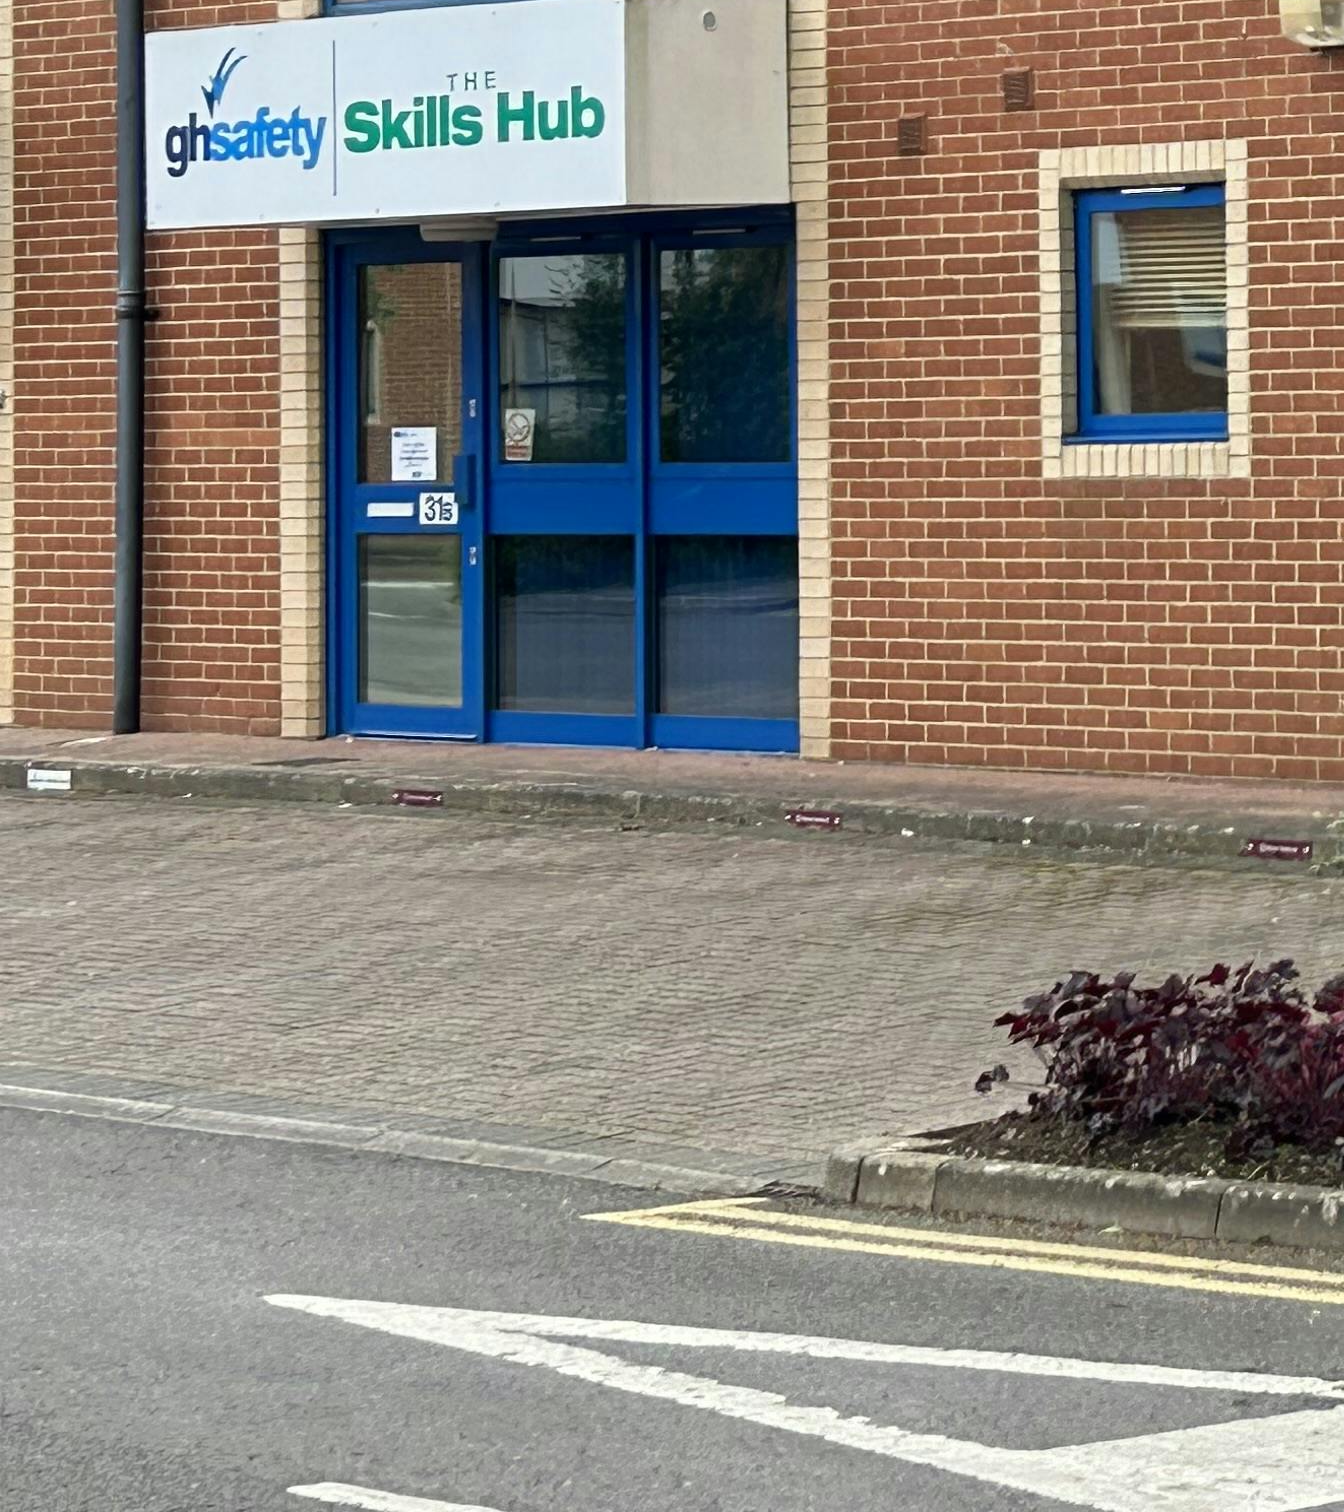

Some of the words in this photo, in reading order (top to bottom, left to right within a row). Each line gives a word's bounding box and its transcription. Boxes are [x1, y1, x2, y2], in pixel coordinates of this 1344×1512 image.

[446, 70, 498, 92] THE
[165, 105, 327, 178] ghsafety
[343, 95, 483, 155] Skills
[496, 85, 606, 144] Hub
